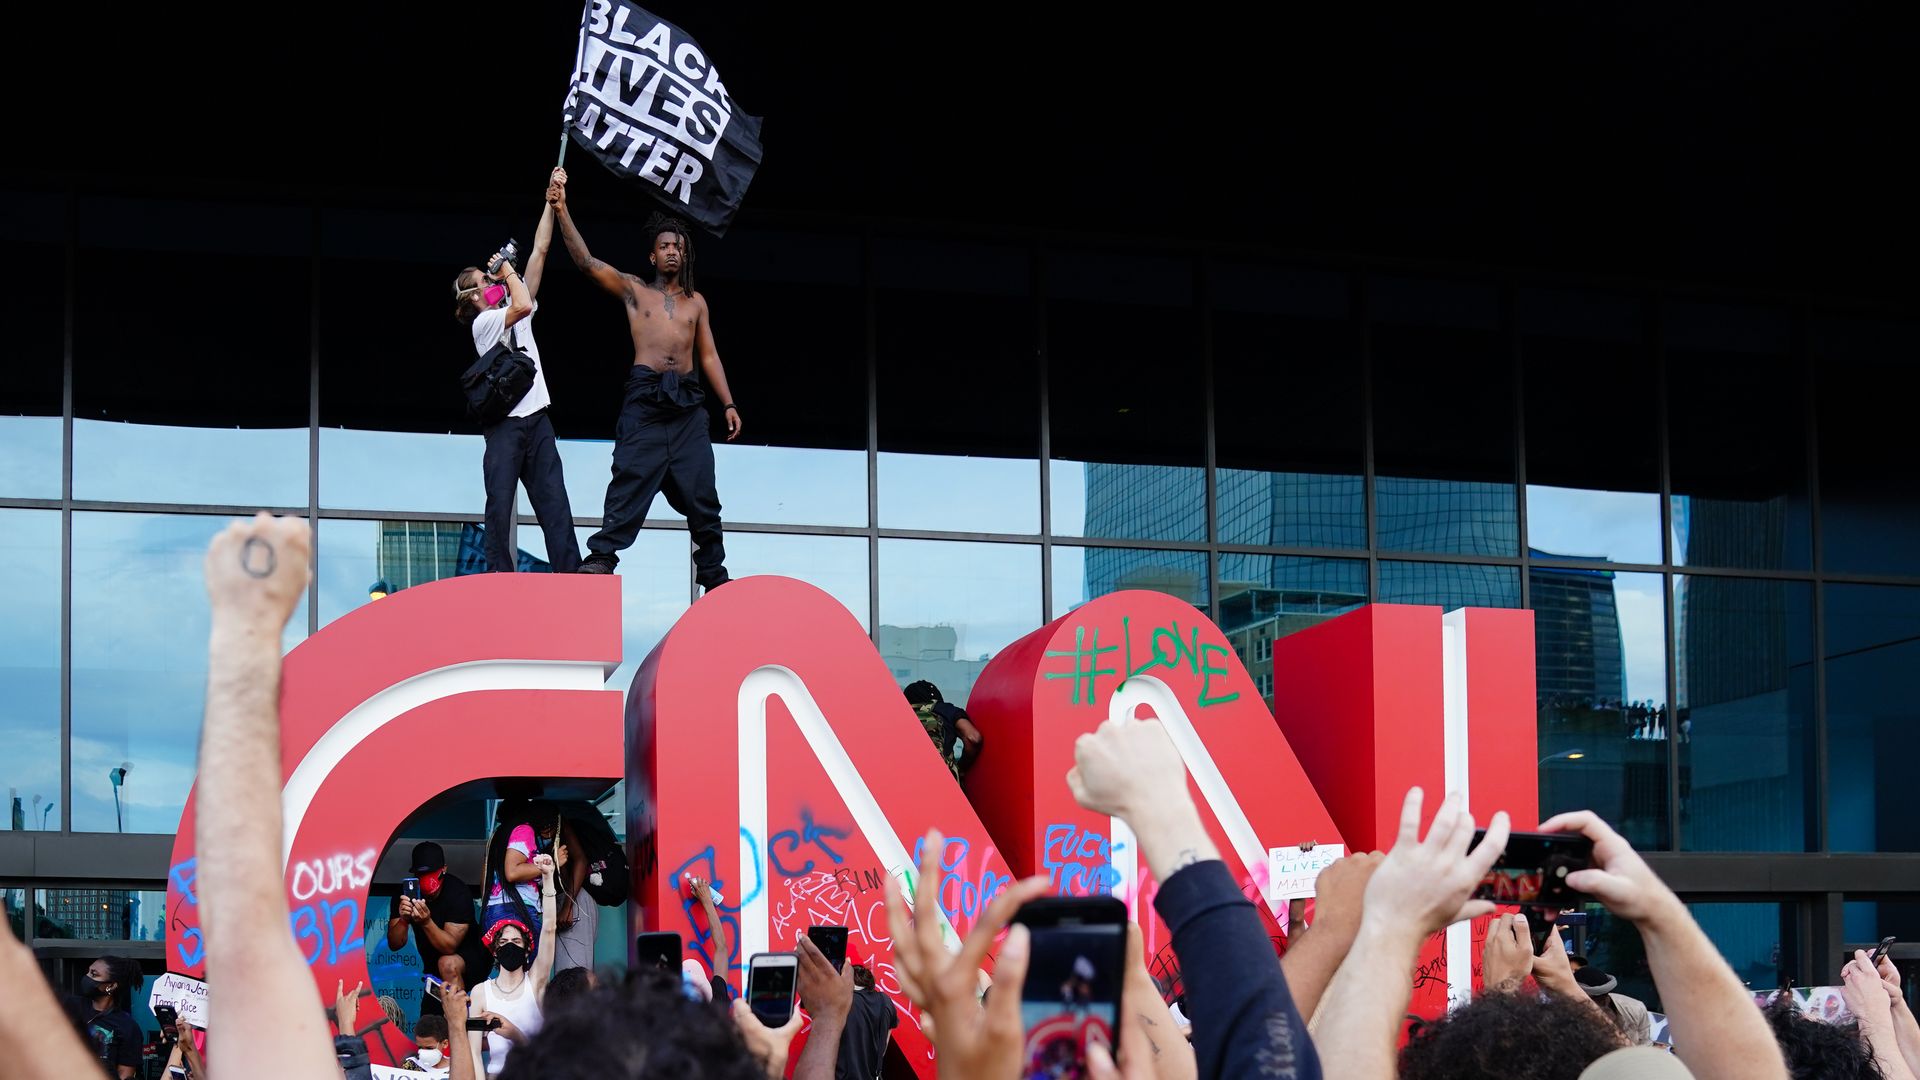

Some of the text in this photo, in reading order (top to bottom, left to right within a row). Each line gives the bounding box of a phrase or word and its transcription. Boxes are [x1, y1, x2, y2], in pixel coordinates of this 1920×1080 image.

[578, 50, 721, 145] IVES
[588, 0, 731, 112] BLACK
[574, 102, 703, 204] ATTER
[1044, 616, 1240, 707] #LOVE
[165, 573, 1537, 1070] CNN
[1275, 848, 1333, 862] BLACK
[291, 849, 376, 900] OURS
[1277, 876, 1318, 890] MAT
